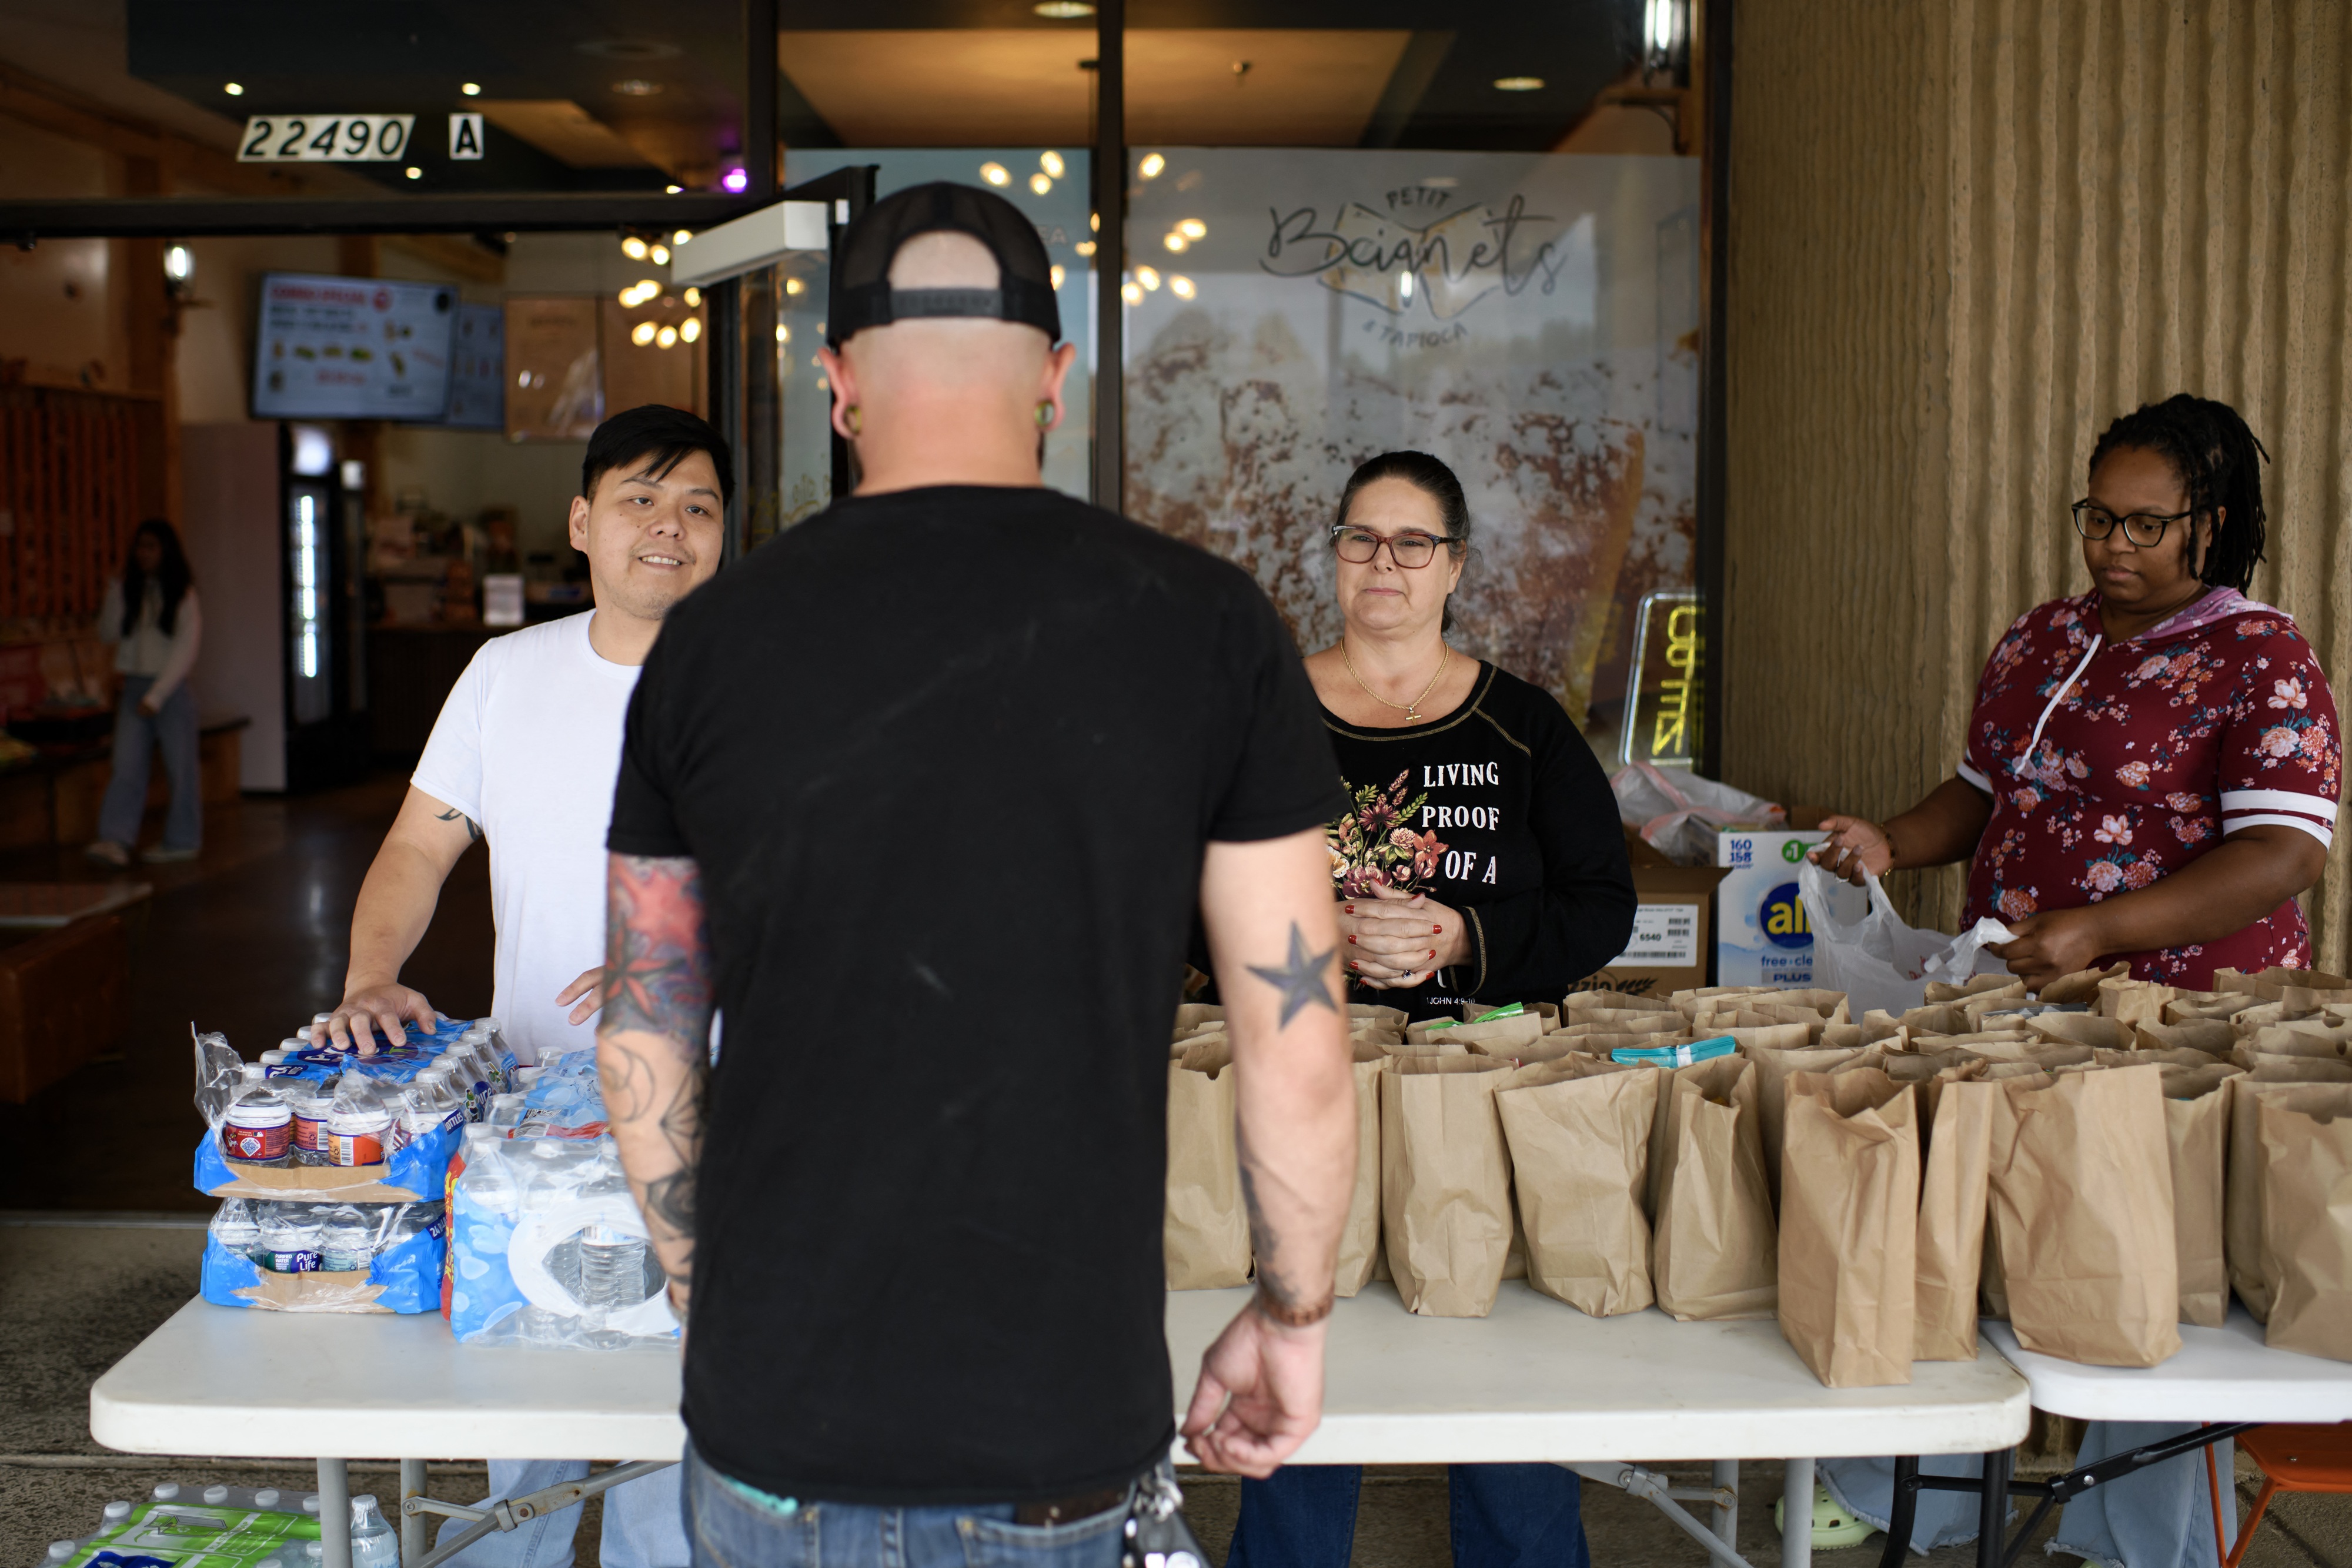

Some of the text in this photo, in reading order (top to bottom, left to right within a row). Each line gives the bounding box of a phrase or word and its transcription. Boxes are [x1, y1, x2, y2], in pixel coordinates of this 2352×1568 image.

[245, 119, 478, 156] 22490 A
[1386, 186, 1451, 209] PETIT
[1380, 322, 1468, 347] TAPIOCA
[1423, 761, 1499, 787] LIVING
[1422, 806, 1499, 830] PROOF
[1730, 839, 1752, 850] 160
[1445, 850, 1496, 884] OF A
[1762, 954, 1813, 967] free cle
[1773, 973, 1811, 982] PLUS
[429, 1225, 440, 1237] 24
[297, 1252, 318, 1262] Pure
[300, 1260, 316, 1272] Life
